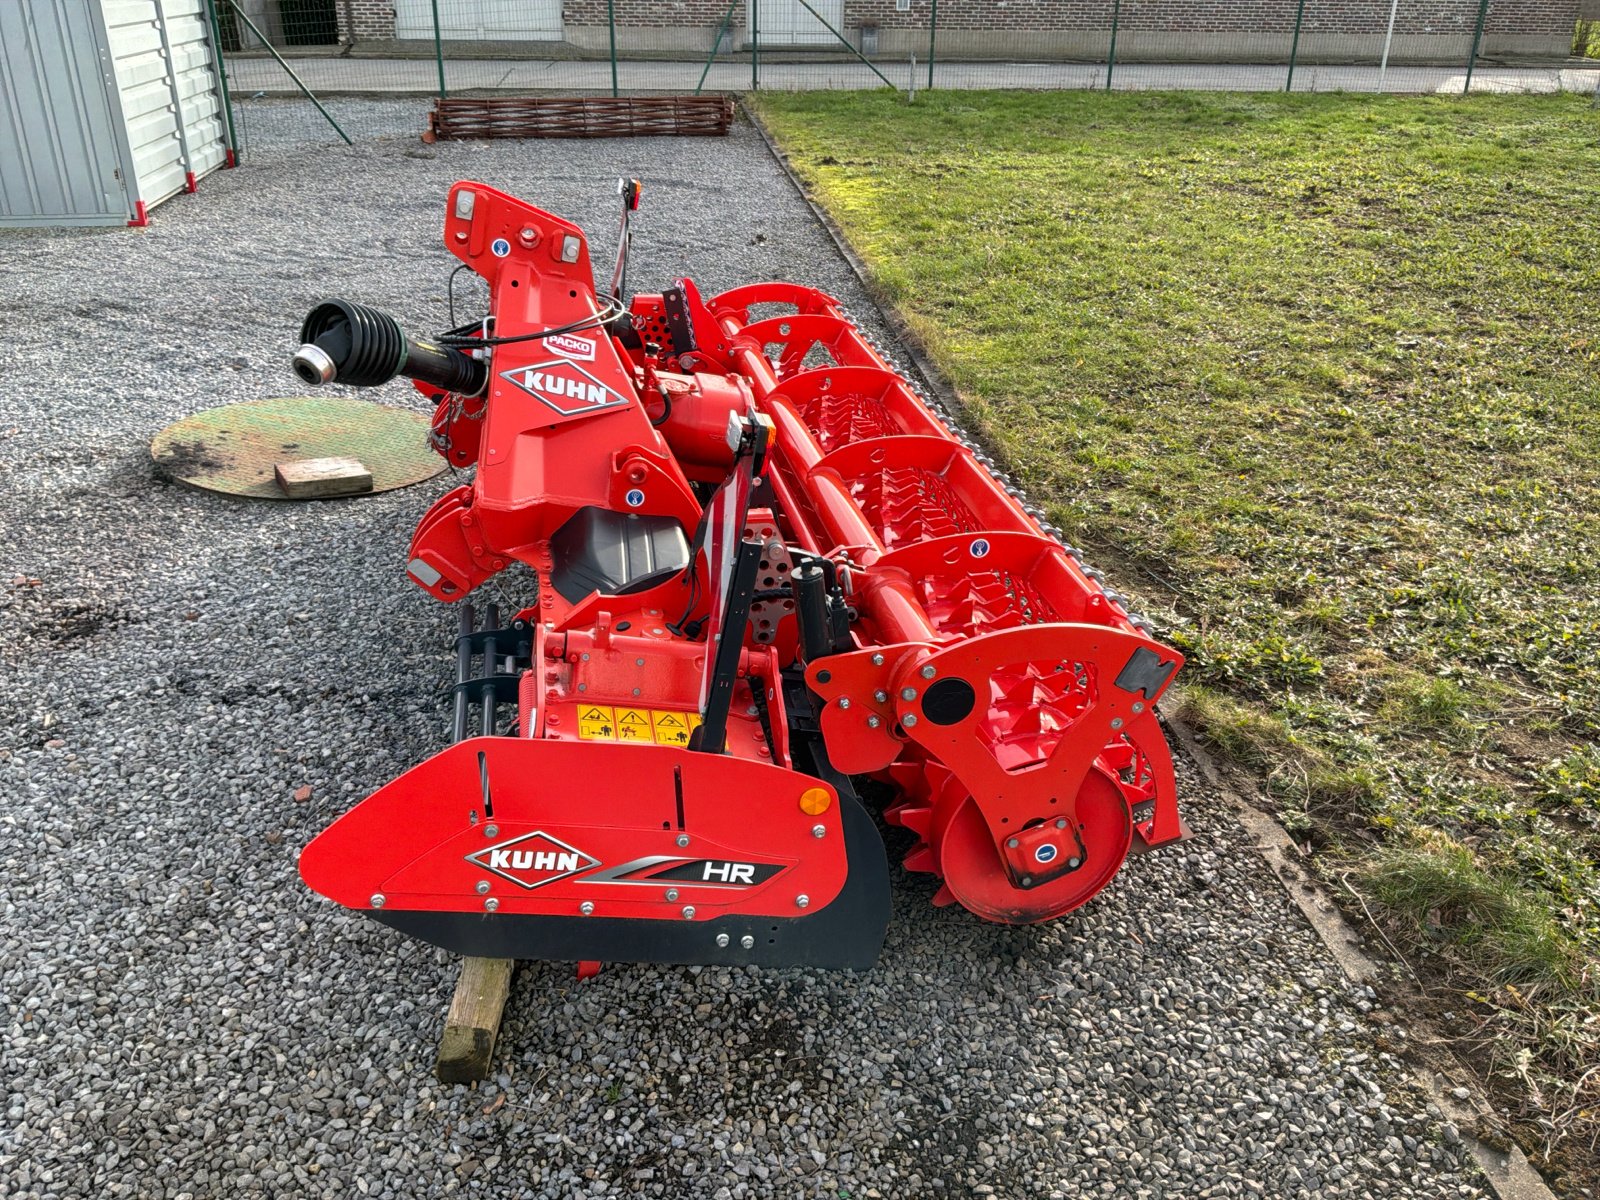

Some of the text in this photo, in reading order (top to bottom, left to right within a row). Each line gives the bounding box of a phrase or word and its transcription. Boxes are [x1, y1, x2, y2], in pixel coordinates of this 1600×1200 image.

[548, 335, 590, 353] PACKO
[524, 370, 606, 405] KUHN
[490, 850, 578, 871] KUHN
[702, 861, 755, 884] HR
